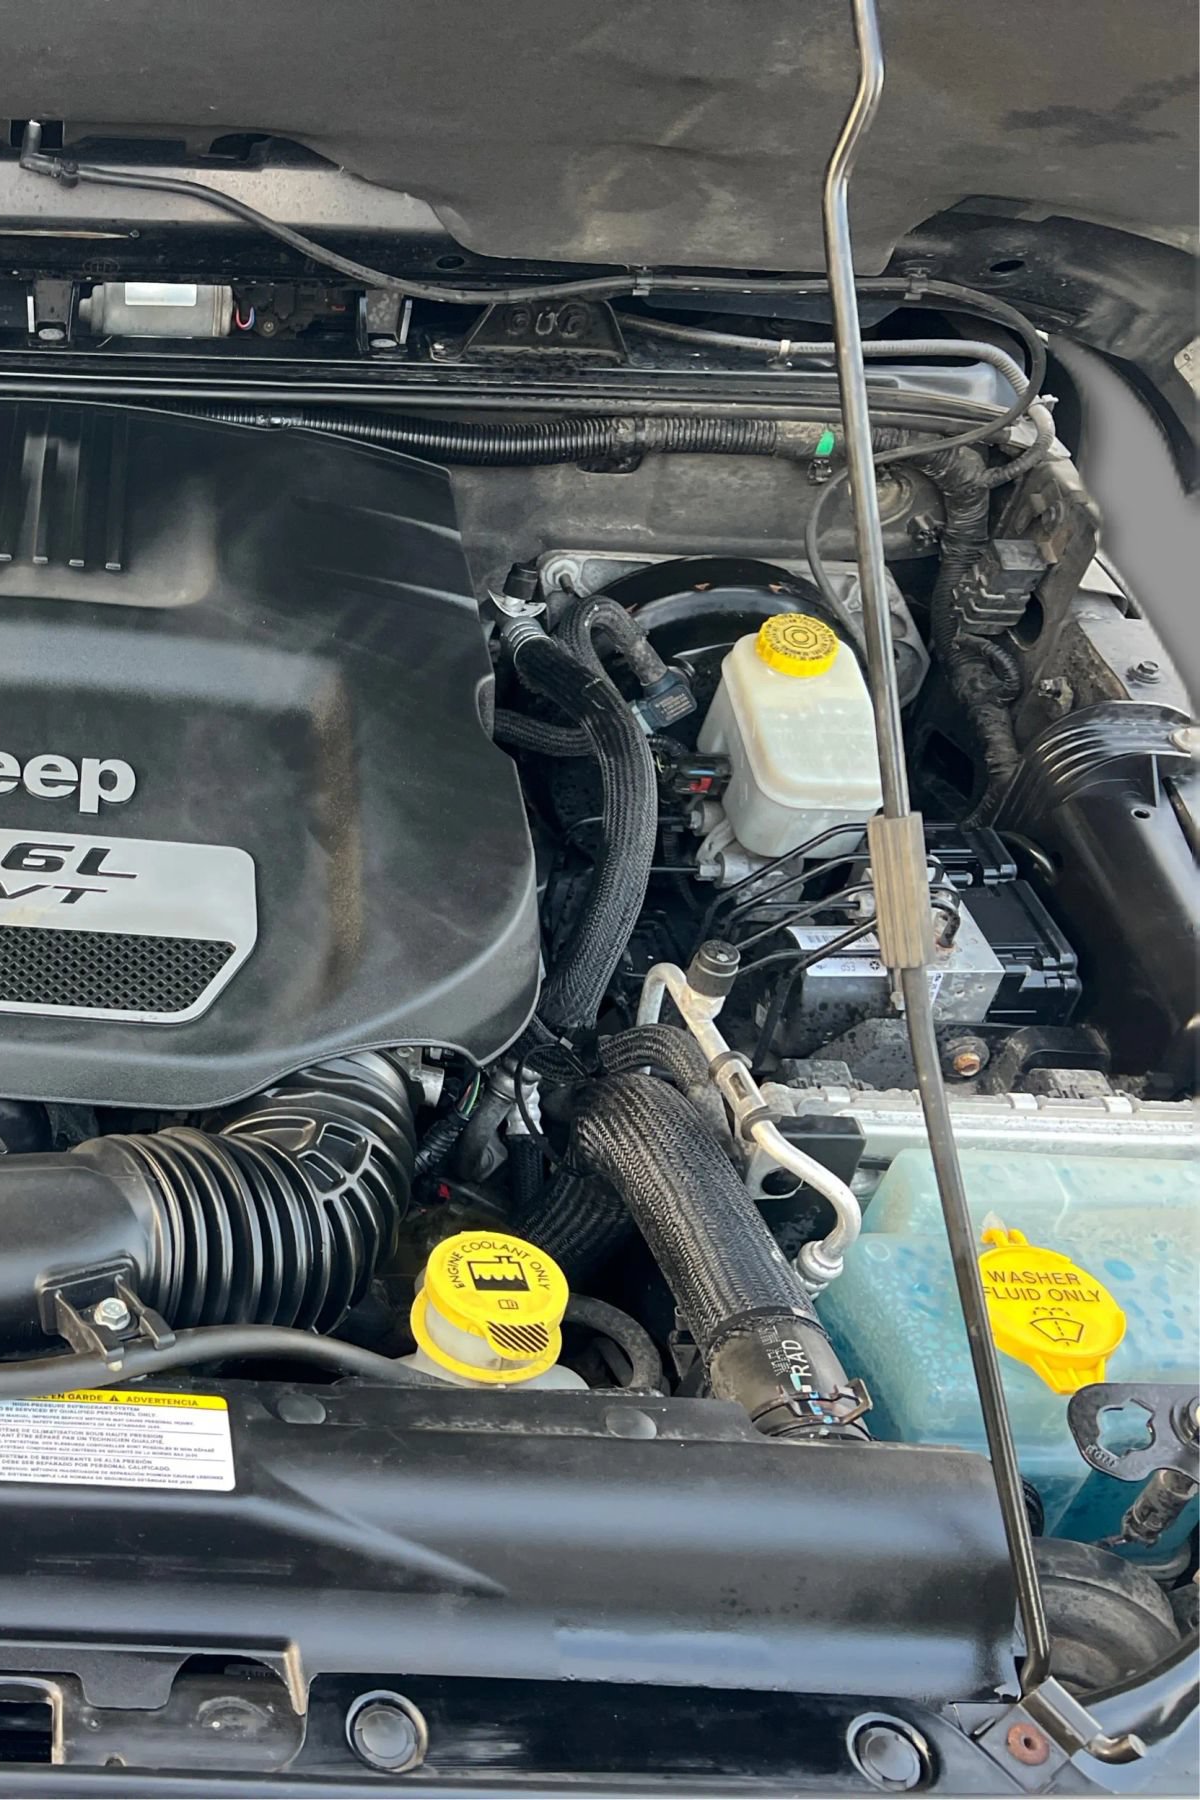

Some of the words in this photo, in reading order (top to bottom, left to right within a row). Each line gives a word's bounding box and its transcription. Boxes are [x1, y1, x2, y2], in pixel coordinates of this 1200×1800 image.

[447, 1251, 465, 1289] ENGINE
[461, 1241, 530, 1259] COOLANT
[530, 1261, 550, 1290] ONLY
[987, 1270, 1081, 1285] WASHER
[1048, 1288, 1101, 1302] ONLY
[781, 1339, 812, 1377] RAD
[68, 1393, 103, 1401] GARDE
[126, 1396, 198, 1407] ADVERTENCIA
